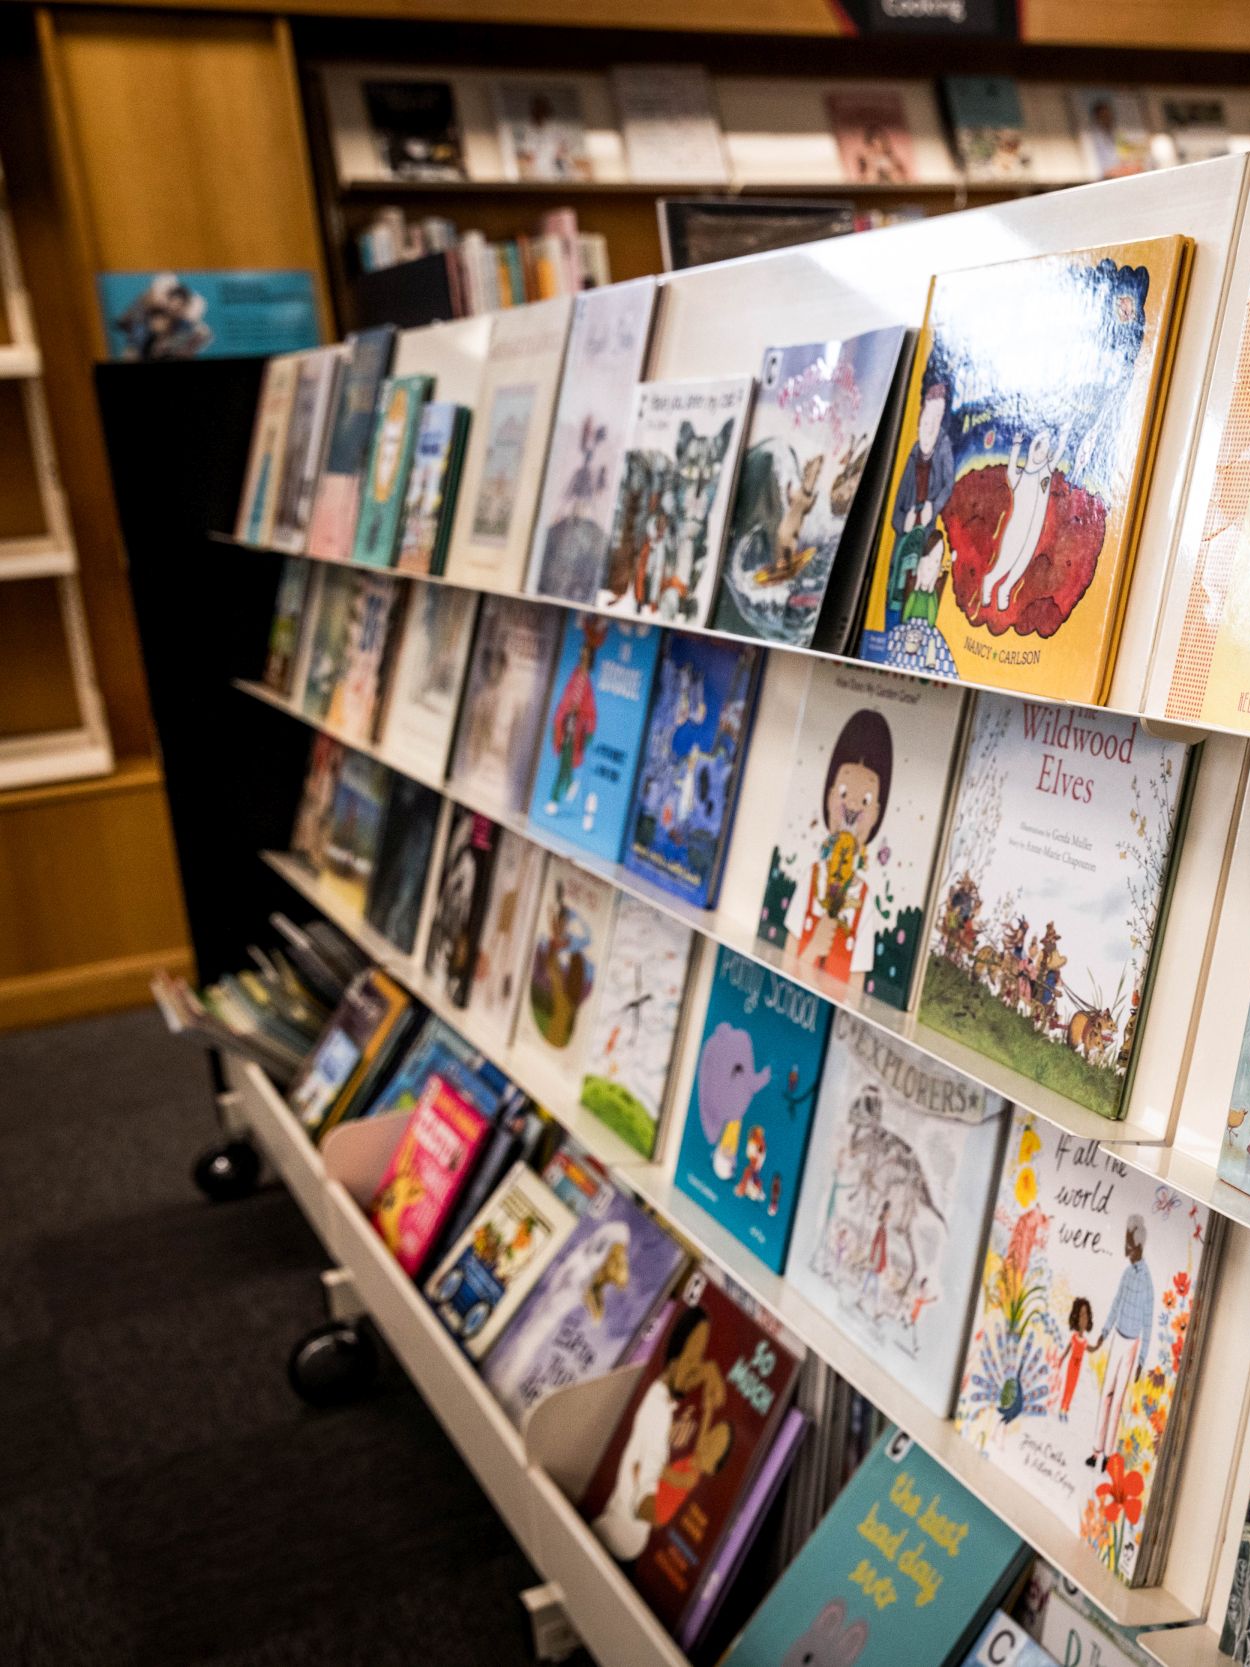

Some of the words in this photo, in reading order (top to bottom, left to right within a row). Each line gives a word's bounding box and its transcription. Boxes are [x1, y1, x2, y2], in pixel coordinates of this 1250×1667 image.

[964, 636, 993, 661] NANCY
[998, 650, 1041, 665] CARLSON
[1023, 702, 1138, 764] Wildwood
[1036, 753, 1094, 804] Elves
[855, 1023, 967, 1114] EXPLORERS
[1073, 1139, 1100, 1168] all
[1054, 1180, 1115, 1214] world
[889, 1471, 922, 1518] the
[917, 1493, 969, 1558] best
[857, 1500, 910, 1562] bad
[897, 1540, 944, 1608] day
[988, 1629, 1016, 1666] C
